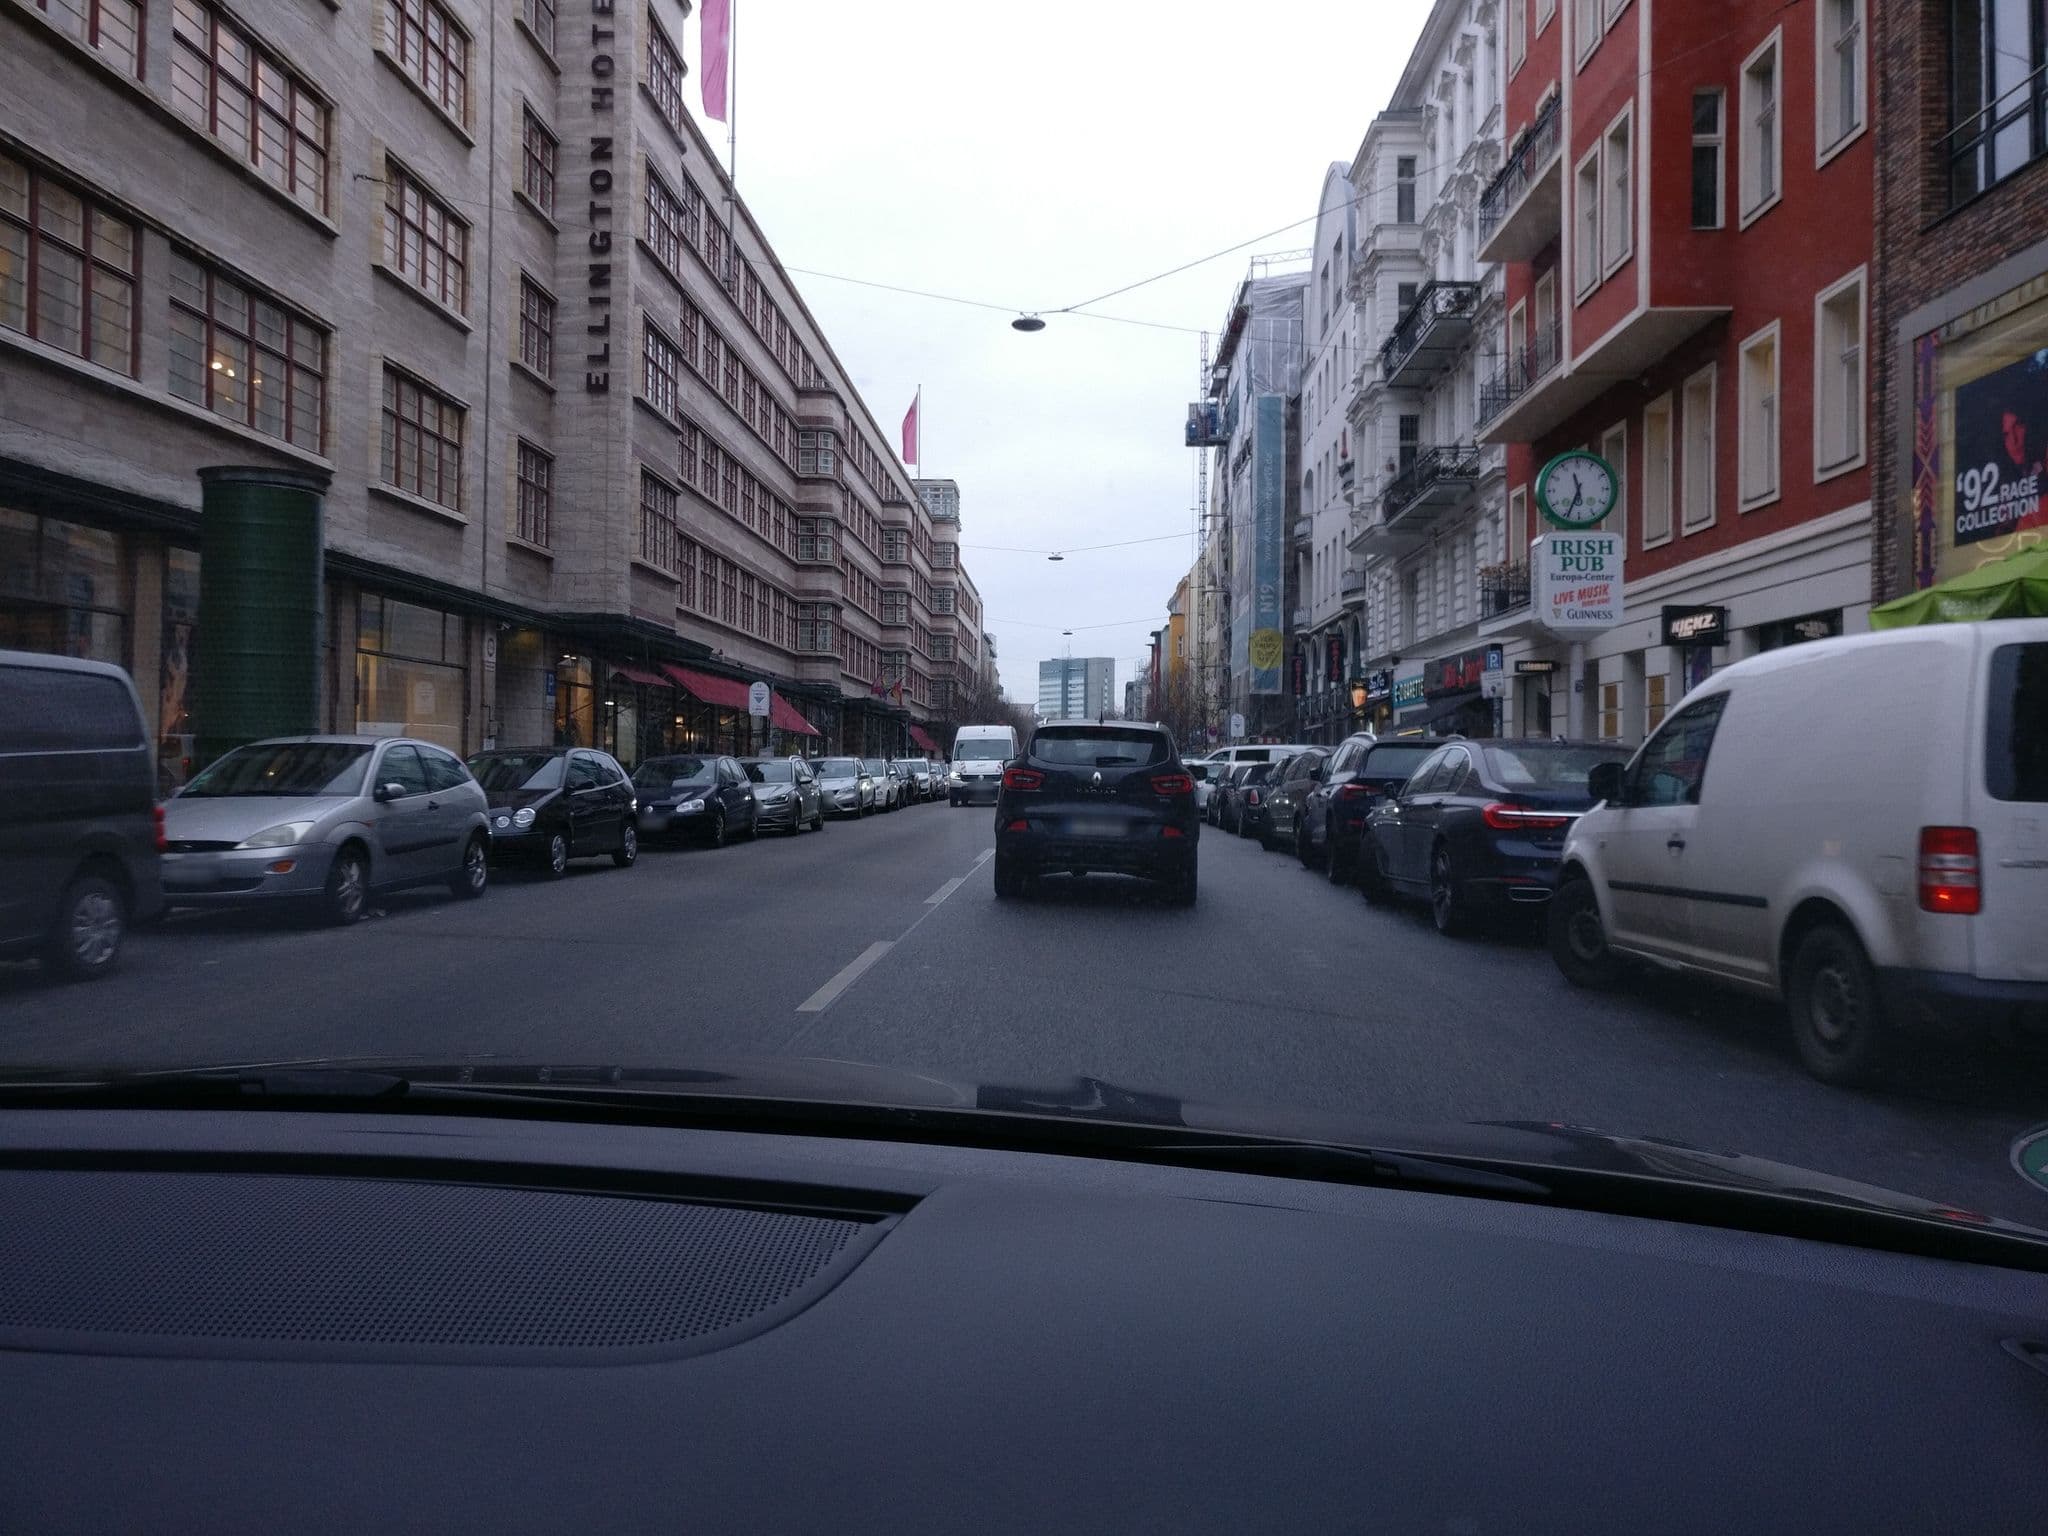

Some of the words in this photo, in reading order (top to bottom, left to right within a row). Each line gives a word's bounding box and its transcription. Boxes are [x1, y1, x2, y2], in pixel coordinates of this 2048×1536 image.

[586, 136, 613, 394] ELLINGTON
[2000, 475, 2039, 500] RAGE
[1956, 495, 2040, 533] COLLECTION
[1551, 540, 1615, 555] IRISH
[1561, 556, 1605, 571] PUB
[1550, 573, 1616, 582] Europa-Center
[1261, 584, 1274, 614] N19
[1553, 590, 1575, 605] LIVE
[1577, 583, 1610, 600] MUSIK
[1566, 608, 1614, 620] GUINNESS
